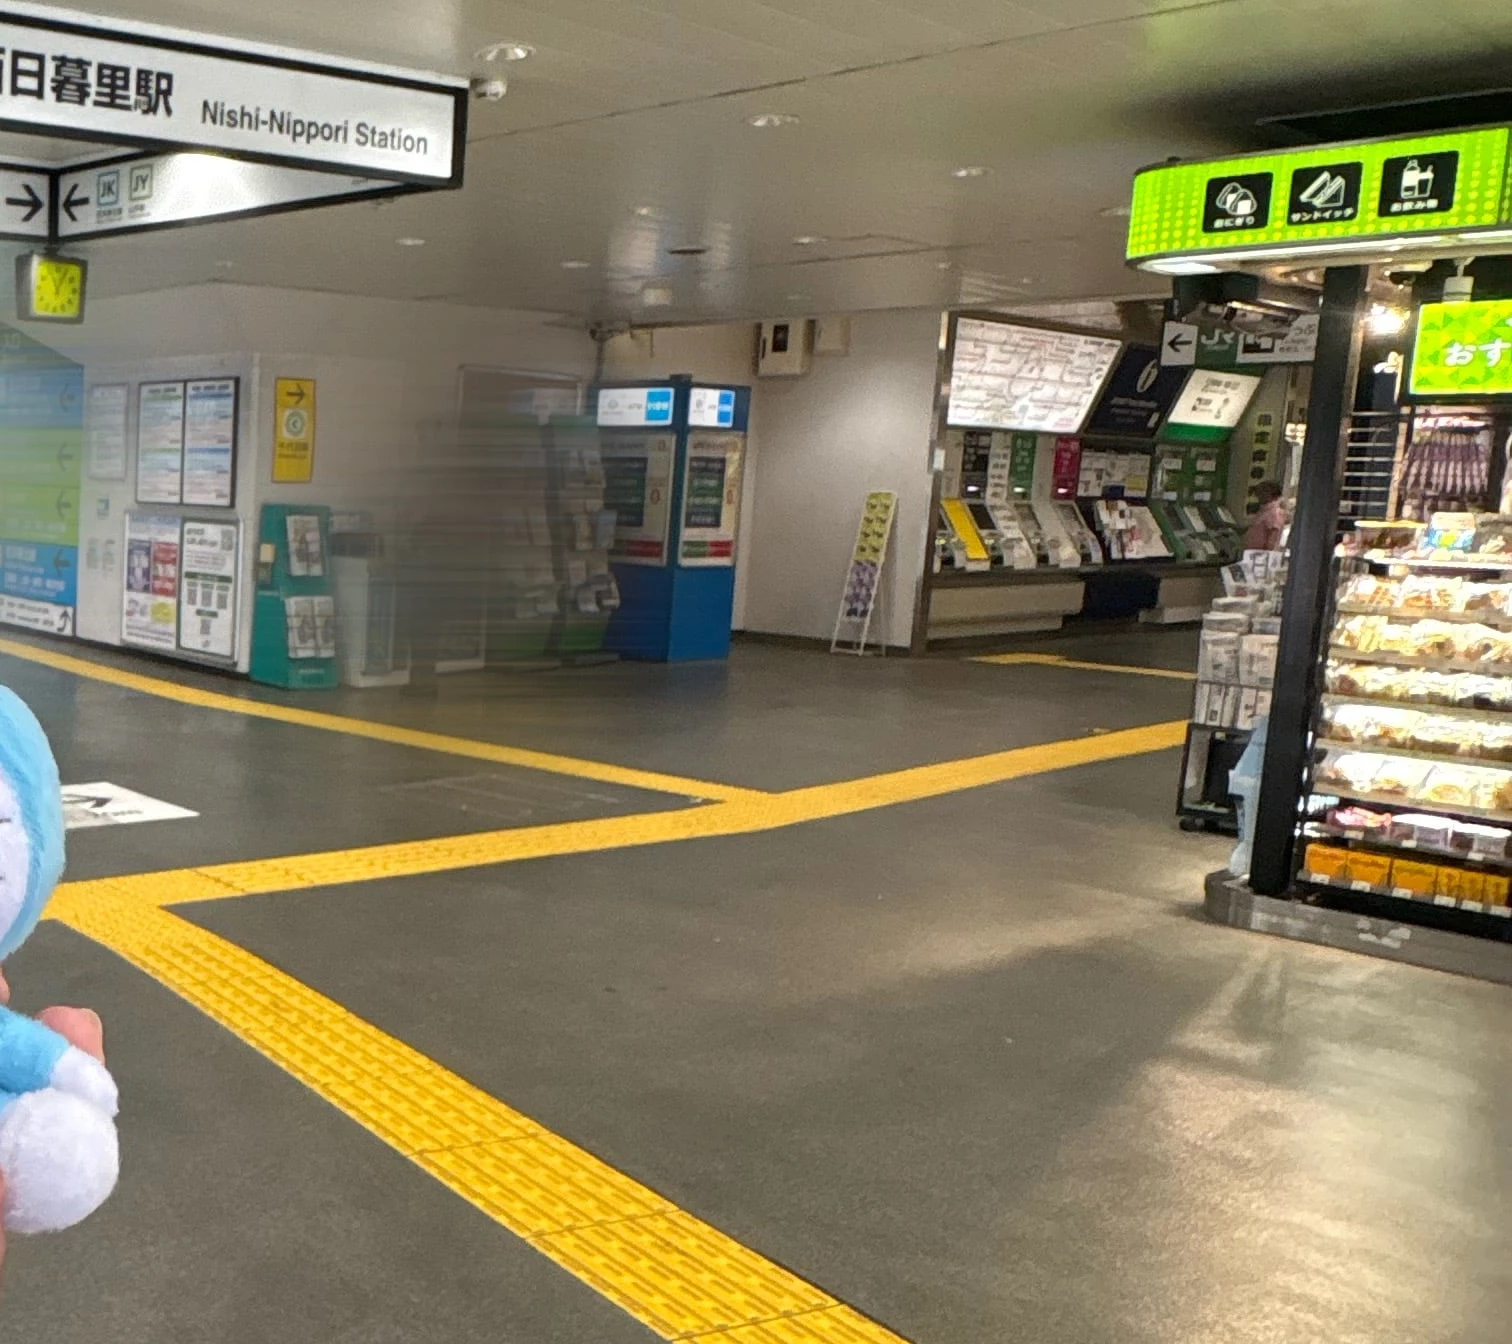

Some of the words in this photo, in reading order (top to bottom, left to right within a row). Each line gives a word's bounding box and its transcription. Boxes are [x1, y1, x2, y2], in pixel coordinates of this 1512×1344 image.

[201, 100, 349, 145] Nishi-Nippori
[355, 122, 428, 154] Station
[99, 180, 116, 198] JK
[133, 174, 149, 192] JY
[1291, 207, 1354, 222] サンドイッチ
